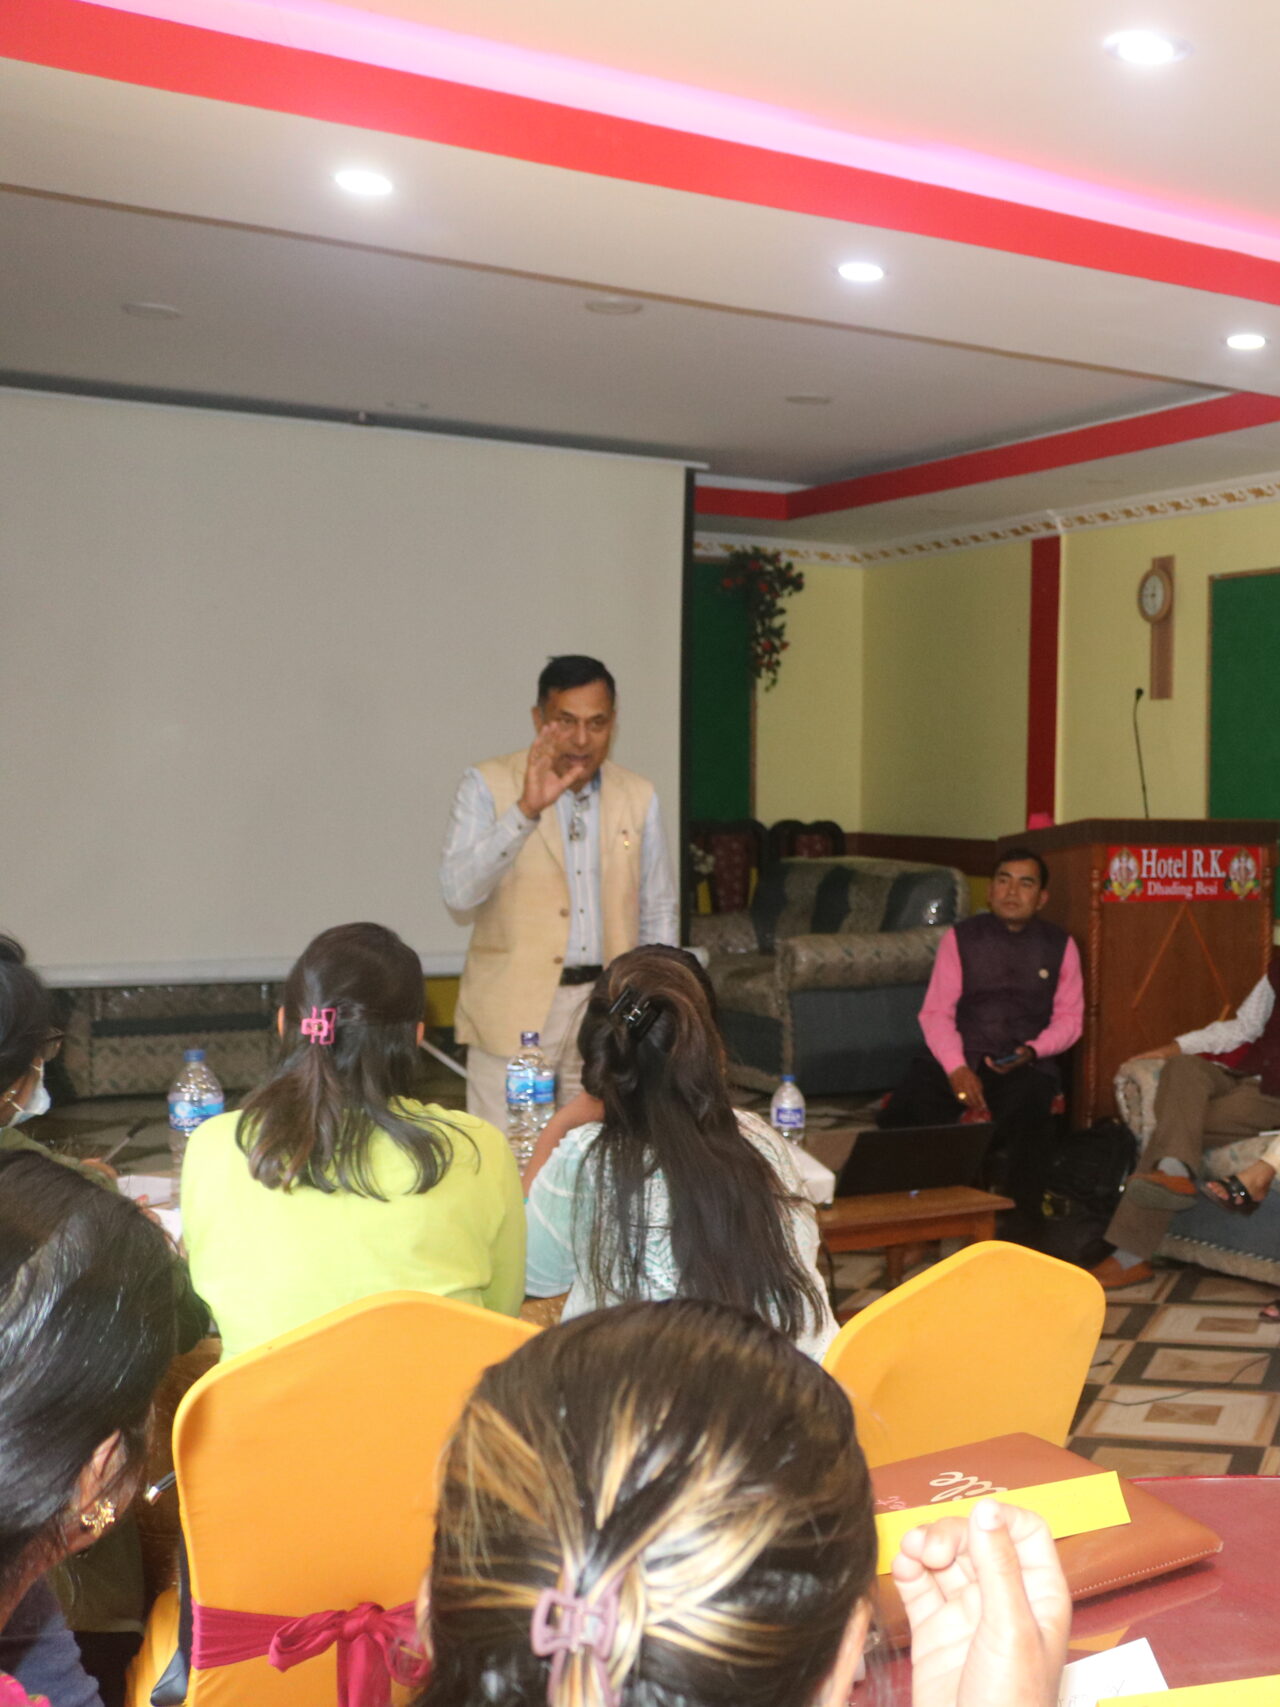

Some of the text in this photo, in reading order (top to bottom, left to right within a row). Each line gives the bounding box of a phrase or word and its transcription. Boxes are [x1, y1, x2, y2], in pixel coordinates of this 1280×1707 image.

[1141, 849, 1226, 879] Hotel R.K.
[1147, 881, 1218, 899] Dhading Besi
